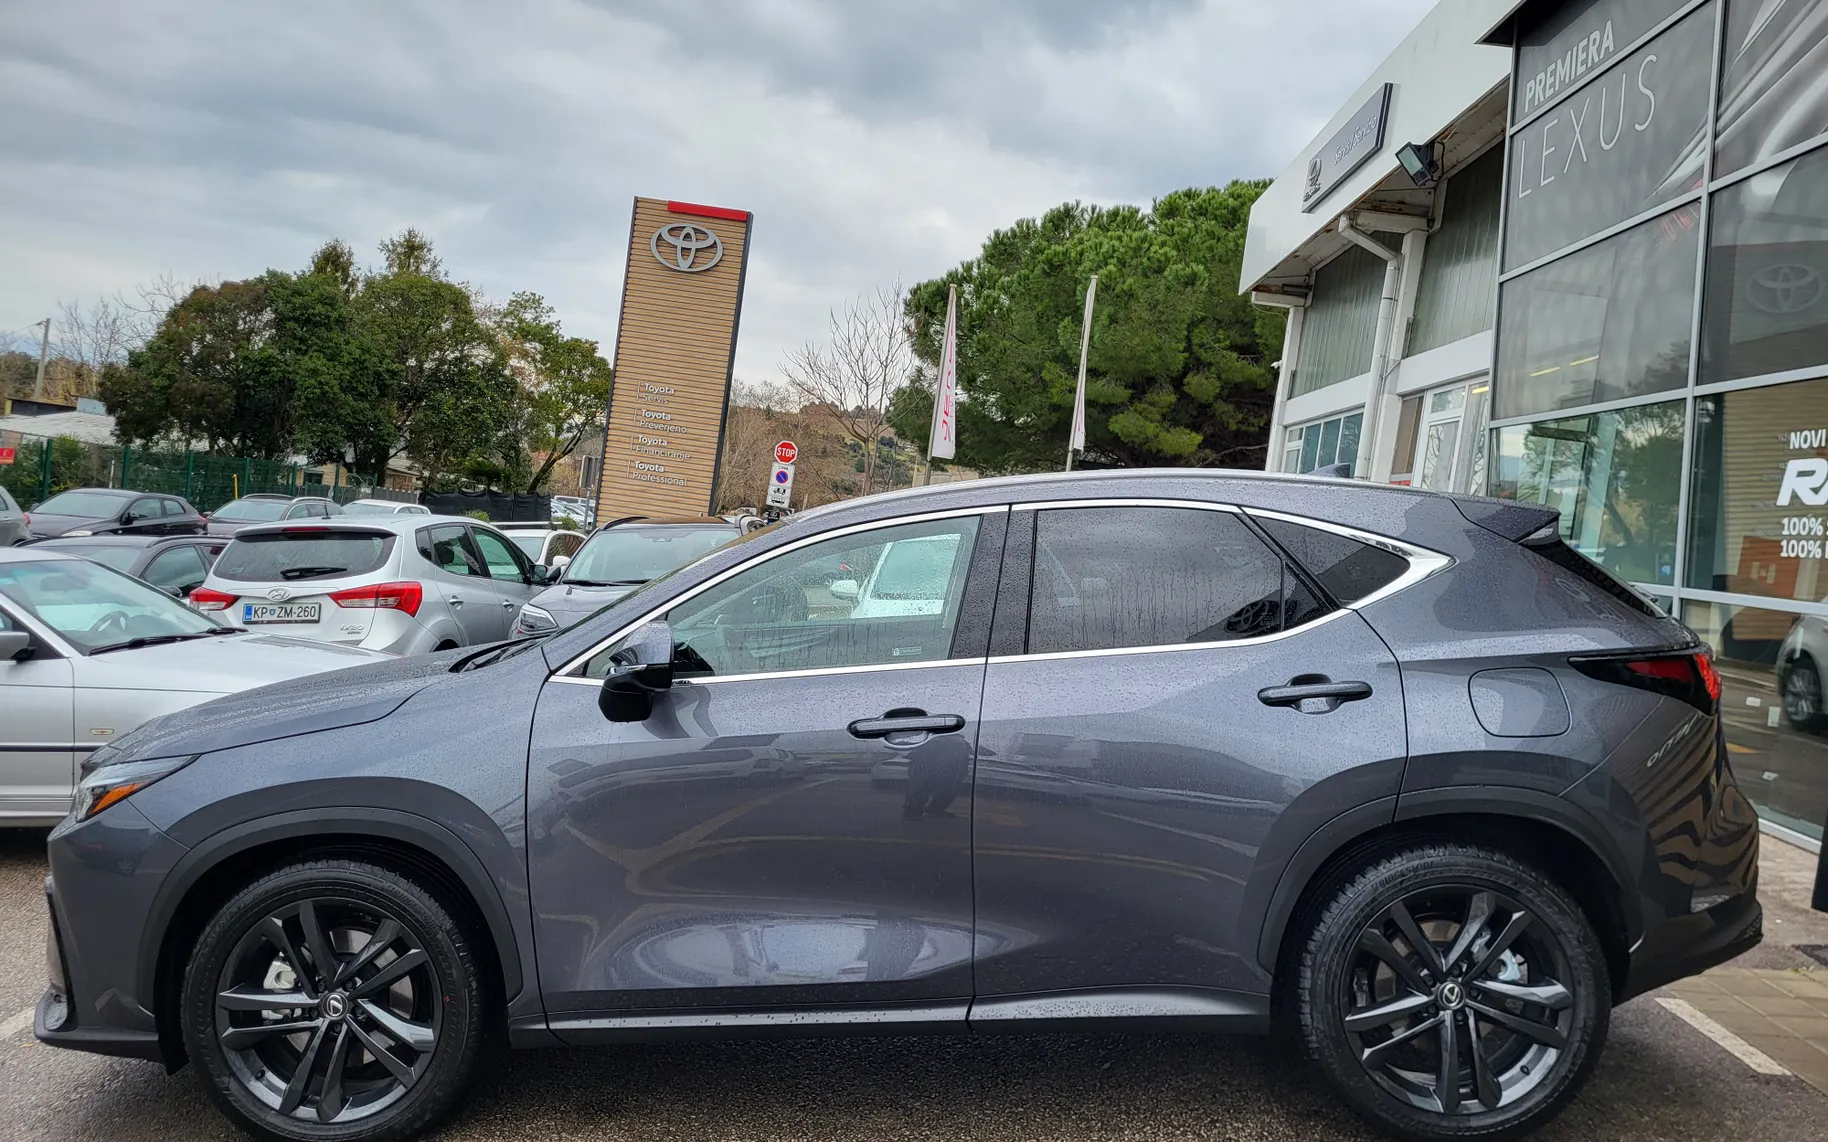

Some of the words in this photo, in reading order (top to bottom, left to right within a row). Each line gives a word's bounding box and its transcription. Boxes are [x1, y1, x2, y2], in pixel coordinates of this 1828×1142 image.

[1525, 20, 1614, 113] PREMIERA
[1519, 54, 1657, 199] LEXUS
[645, 383, 675, 394] Toyota
[642, 394, 668, 405] Servis
[641, 409, 671, 421] Toyota
[640, 420, 688, 433] Preverjeno
[638, 435, 668, 446] Toyota
[1789, 429, 1826, 450] NOVI
[635, 446, 690, 461] Financiranje
[777, 447, 796, 458] STOP
[635, 461, 664, 472] Toyota
[632, 472, 688, 486] Professional
[1781, 517, 1823, 536] 100%
[1780, 540, 1822, 559] 100%
[253, 607, 268, 619] KP
[277, 606, 316, 618] ZM-260
